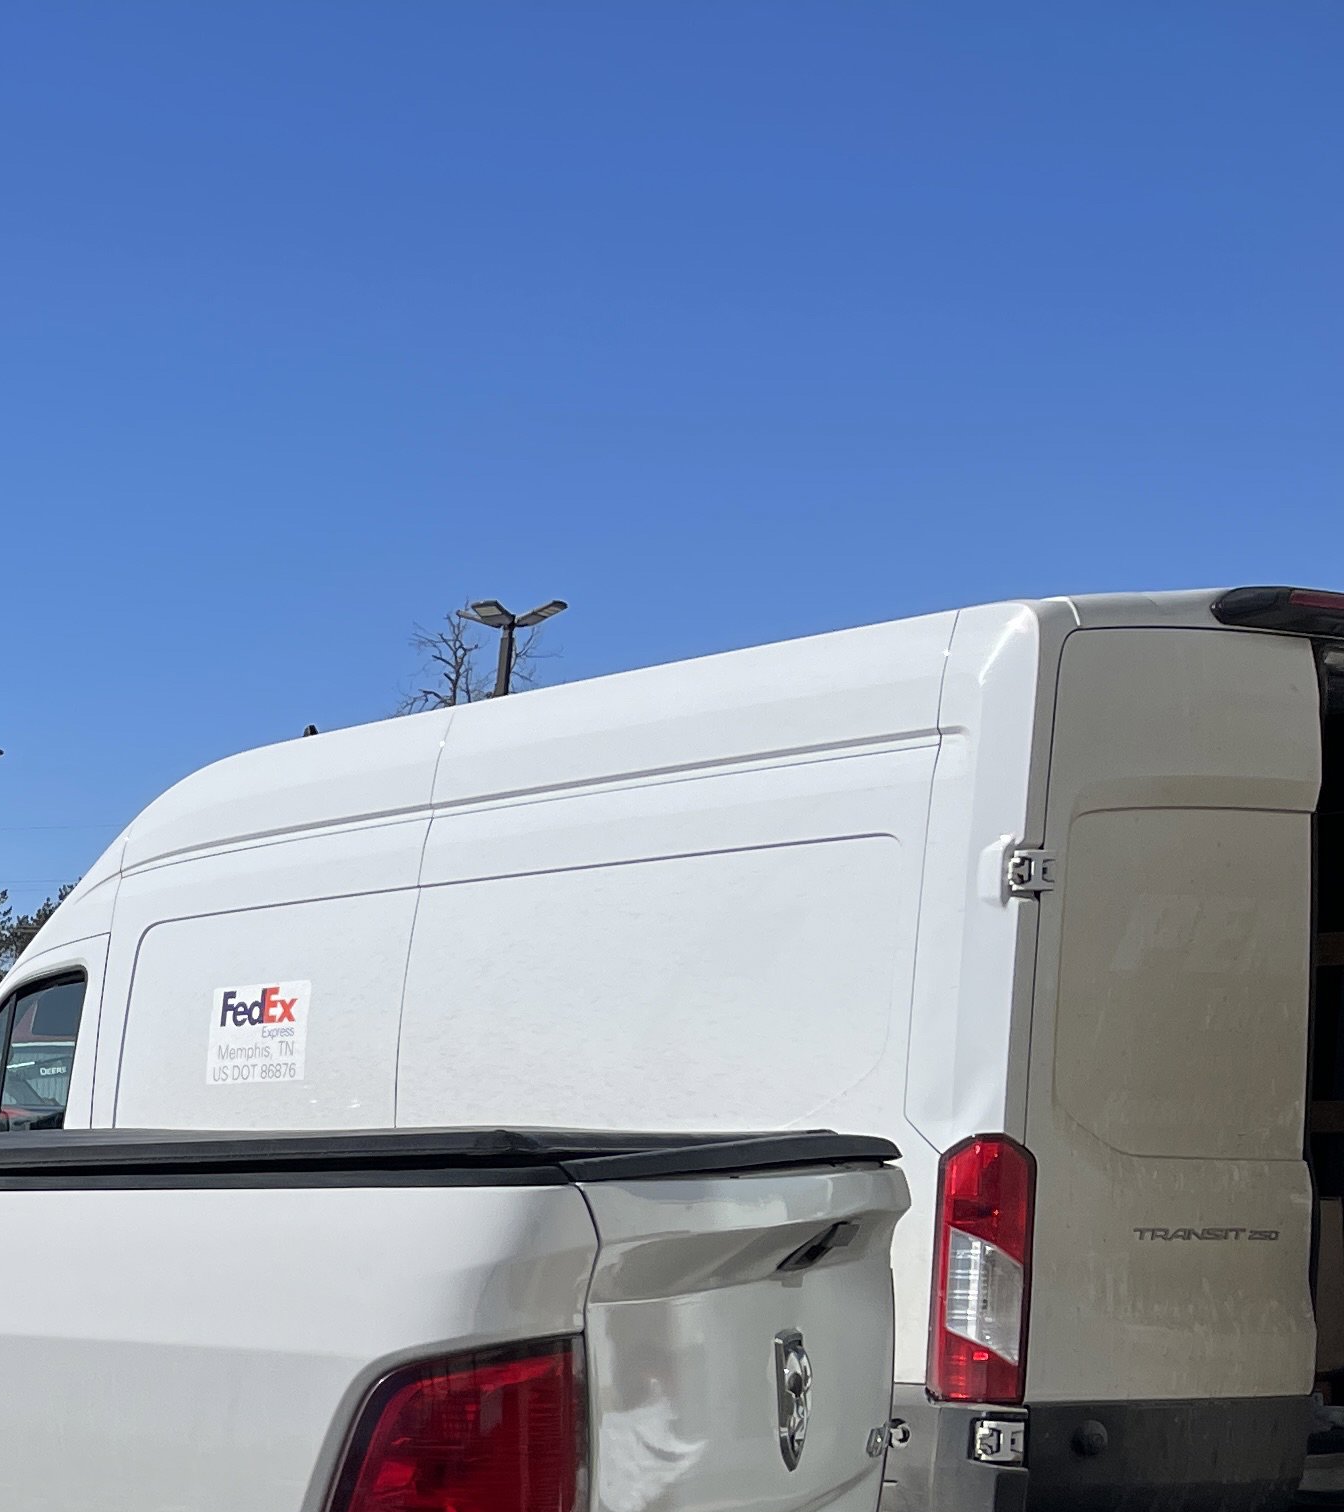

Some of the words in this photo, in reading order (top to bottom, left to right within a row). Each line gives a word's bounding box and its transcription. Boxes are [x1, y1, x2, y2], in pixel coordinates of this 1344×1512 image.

[220, 987, 298, 1027] FedEx
[261, 1026, 294, 1040] Express
[218, 1043, 273, 1061] Memphis,
[278, 1040, 294, 1057] TN
[213, 1065, 229, 1082] US
[232, 1064, 257, 1081] DOT
[260, 1063, 296, 1080] 86876
[1133, 1227, 1247, 1242] TRANSIT
[1248, 1230, 1281, 1241] 250
